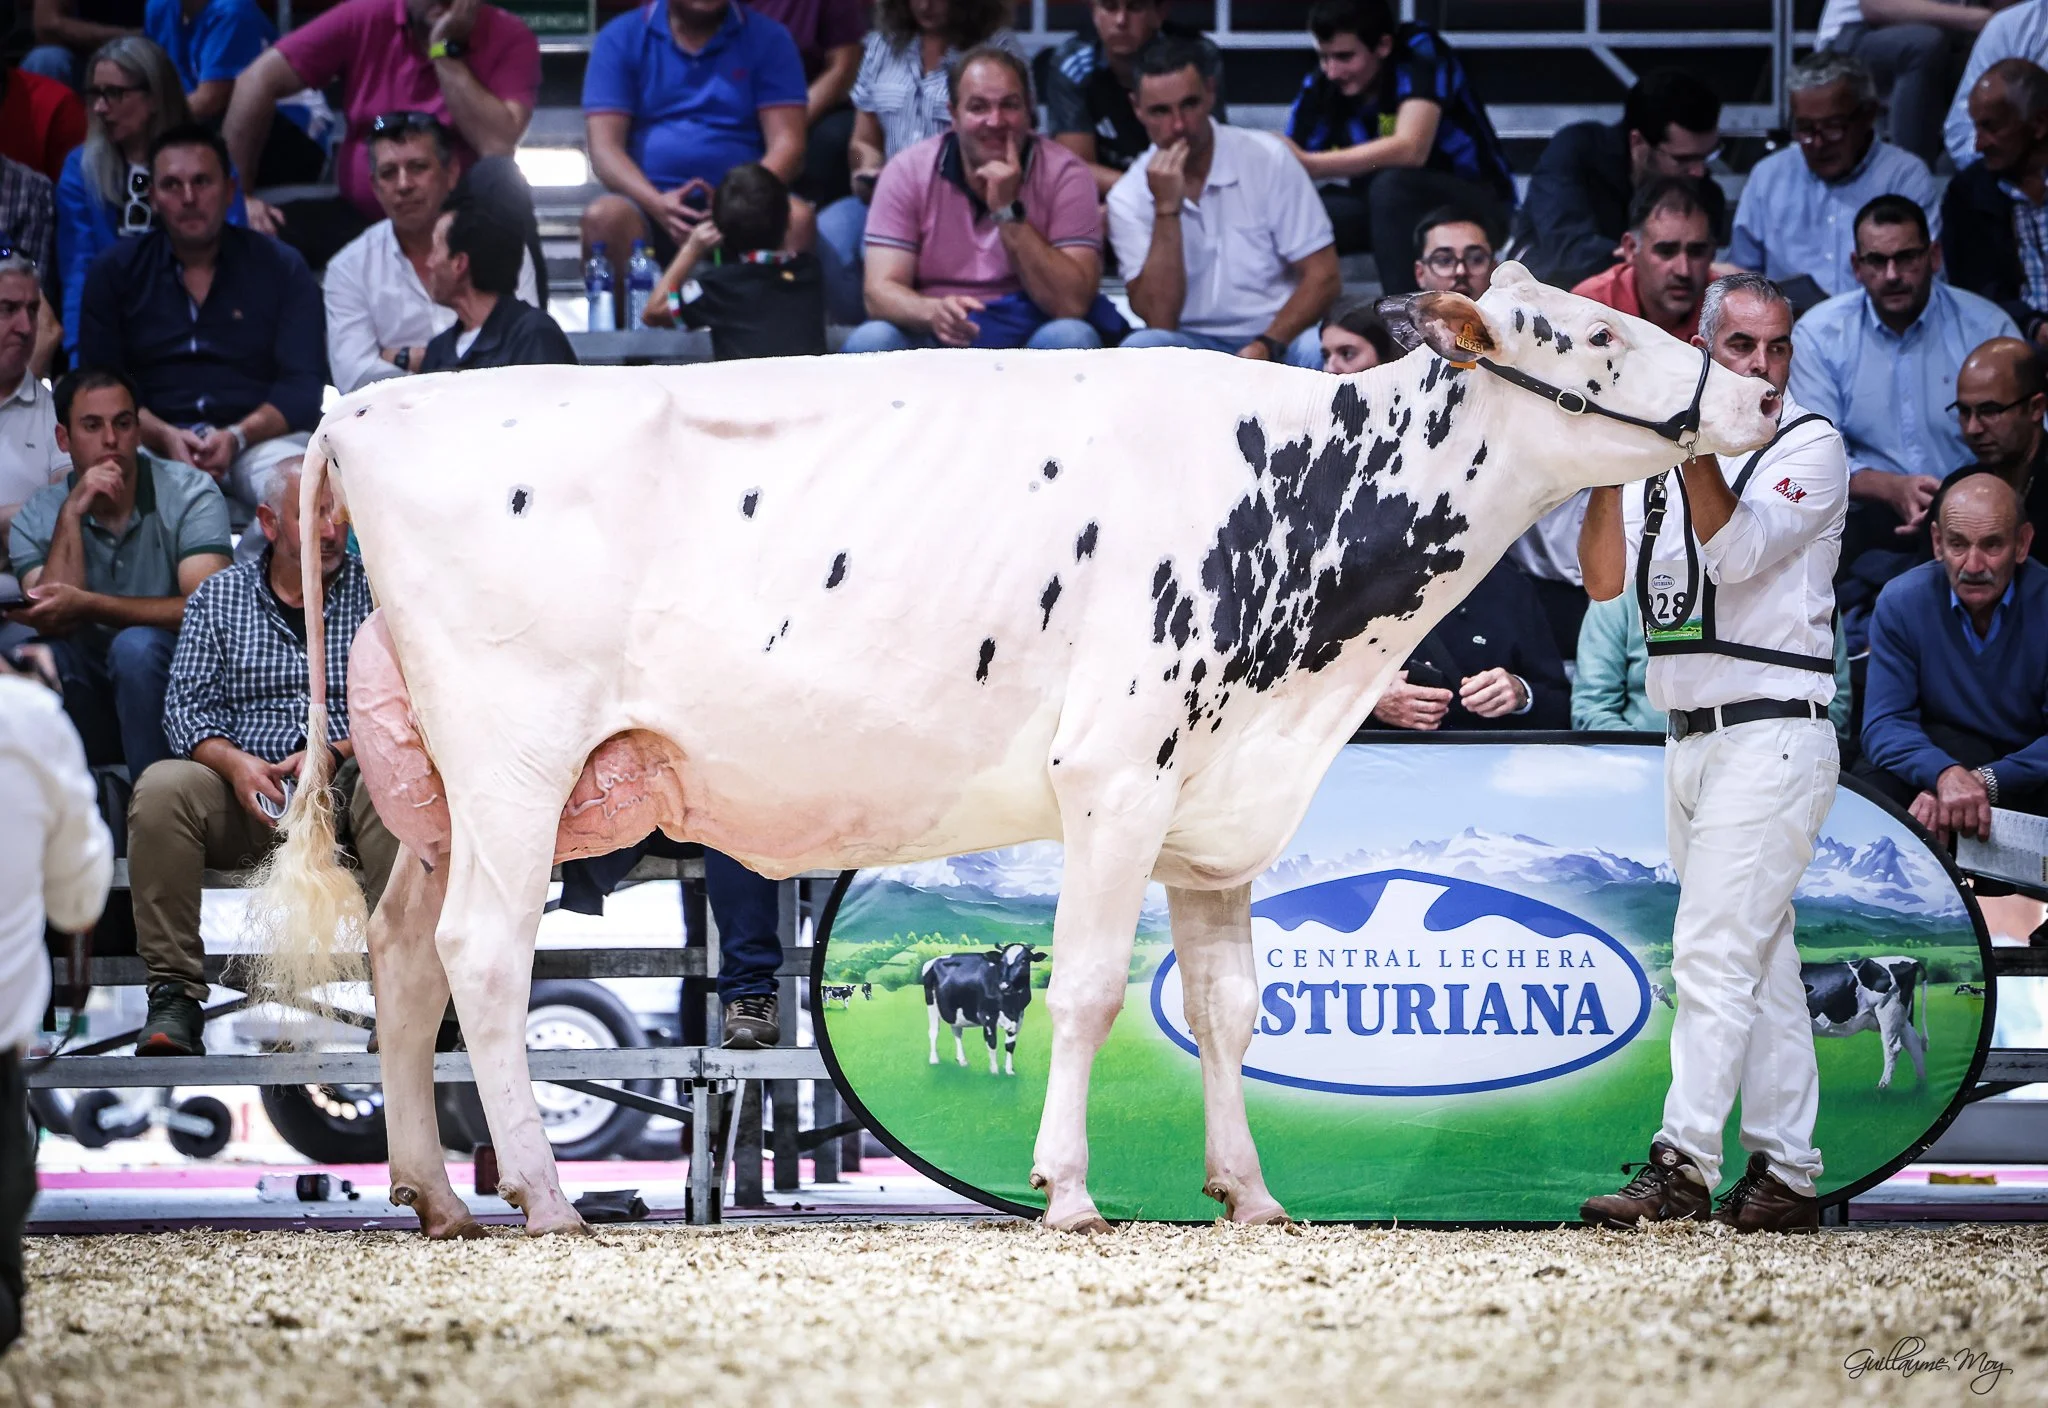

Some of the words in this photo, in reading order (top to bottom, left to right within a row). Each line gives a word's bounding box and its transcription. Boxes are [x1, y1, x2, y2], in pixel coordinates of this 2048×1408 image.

[1648, 592, 1688, 619] 28
[1267, 949, 1421, 968] CENTRAL
[1439, 949, 1596, 968] LECHERA
[1188, 980, 1614, 1036] STURIANA
